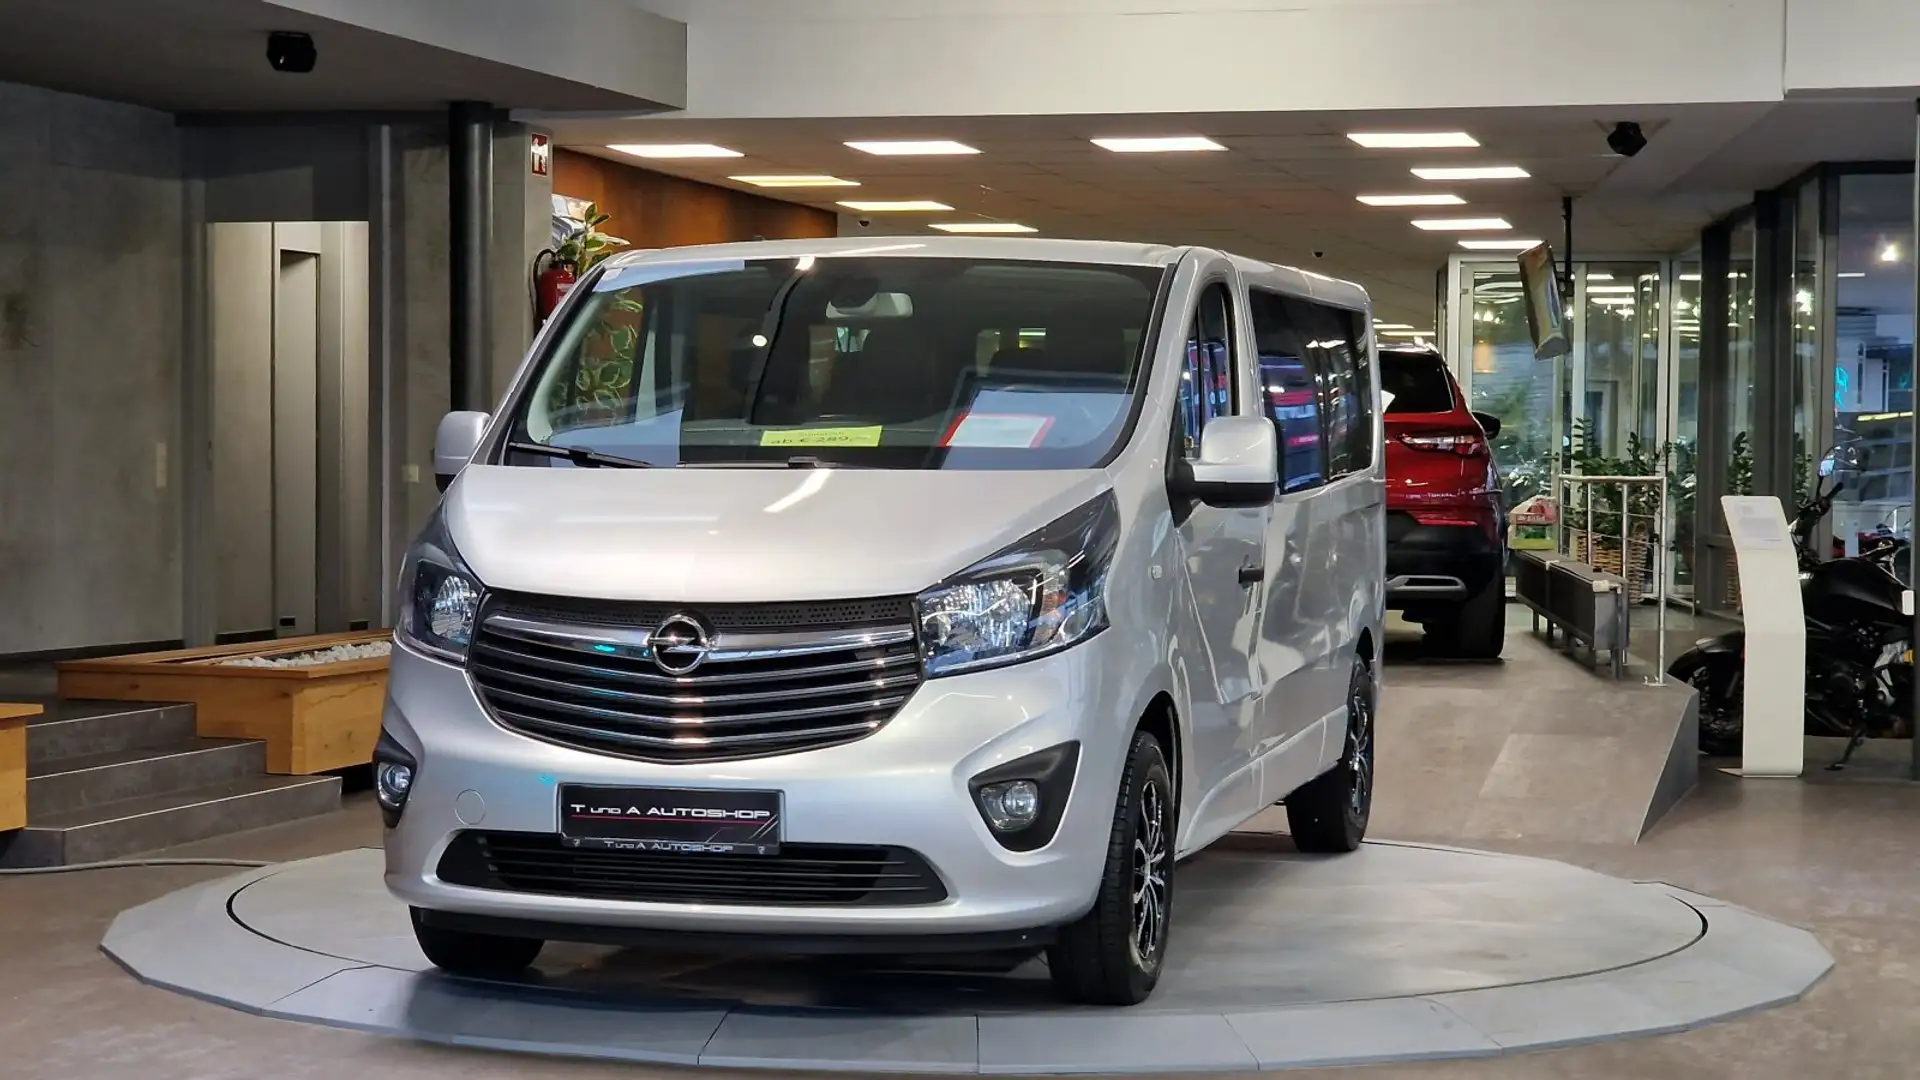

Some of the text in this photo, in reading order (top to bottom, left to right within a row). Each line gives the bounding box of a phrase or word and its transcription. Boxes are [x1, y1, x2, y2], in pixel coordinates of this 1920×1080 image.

[570, 803, 586, 813] T
[626, 806, 641, 815] A
[646, 807, 771, 819] AUTOSHOP
[603, 840, 615, 848] T
[636, 842, 646, 850] A
[651, 842, 734, 853] AUTOSHOP
